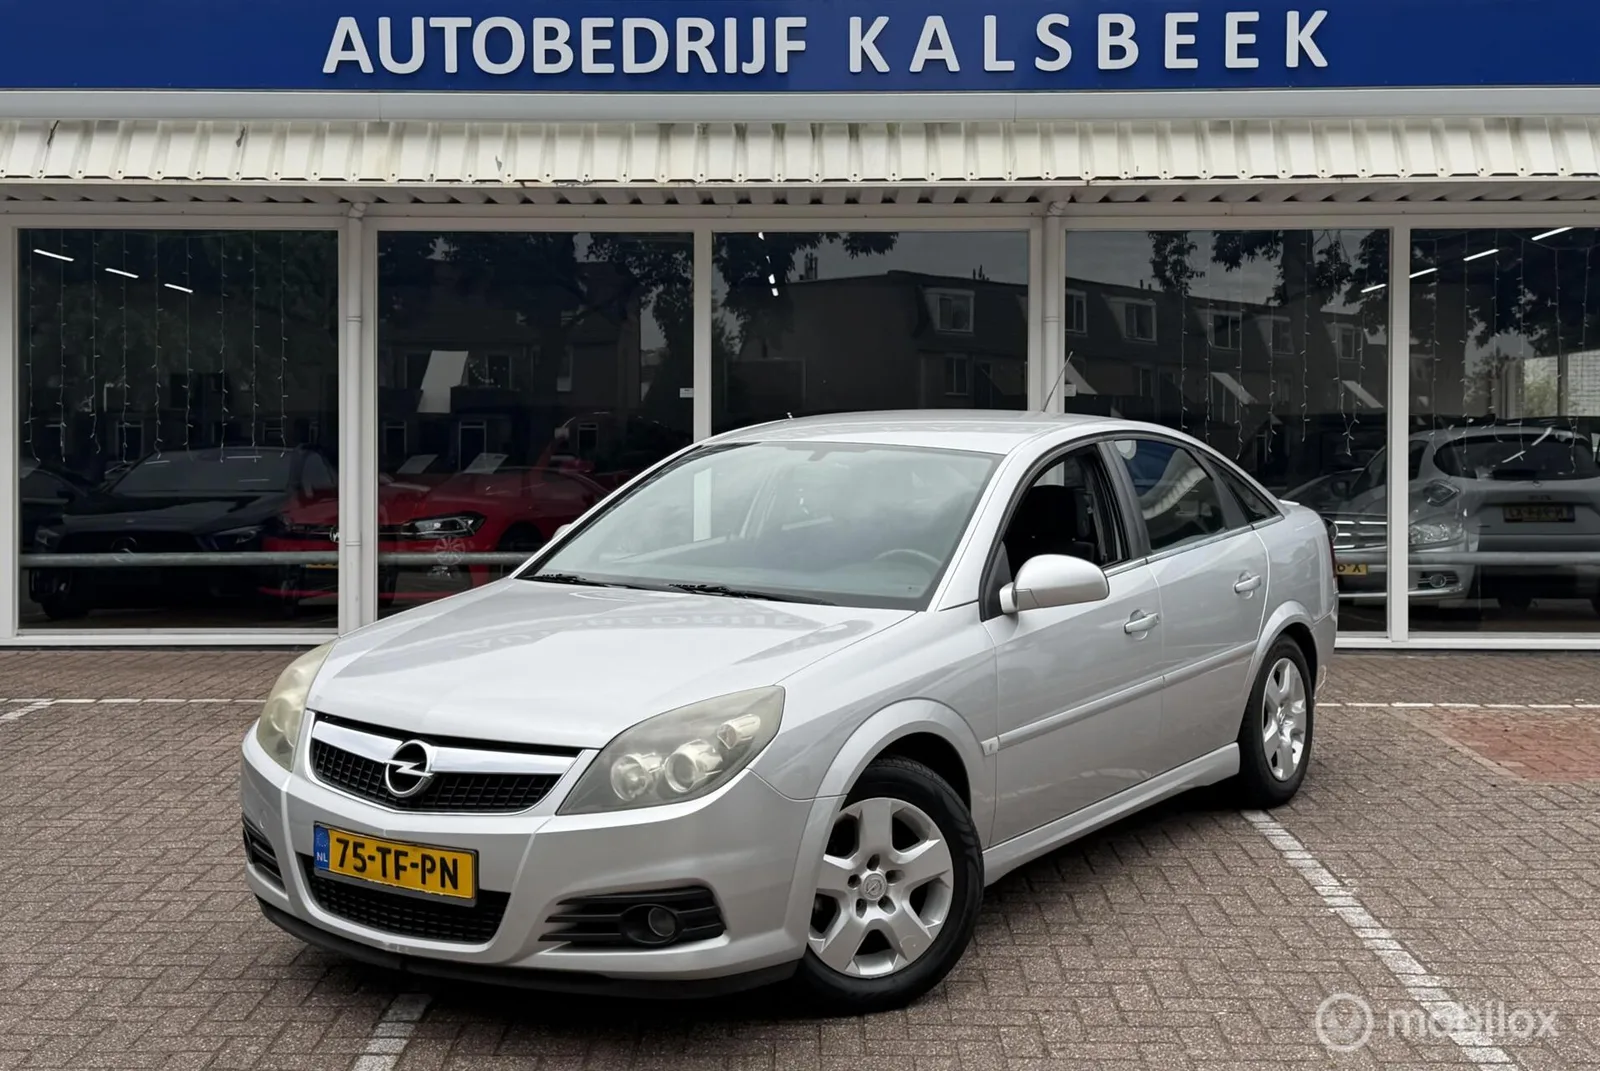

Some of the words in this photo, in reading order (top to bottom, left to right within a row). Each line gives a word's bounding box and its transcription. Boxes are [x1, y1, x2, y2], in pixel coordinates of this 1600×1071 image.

[322, 16, 808, 75] AUTOBEDRIJF
[848, 10, 1329, 73] KALSBEEK
[316, 851, 329, 863] NL
[336, 838, 459, 890] 75-TF-PN
